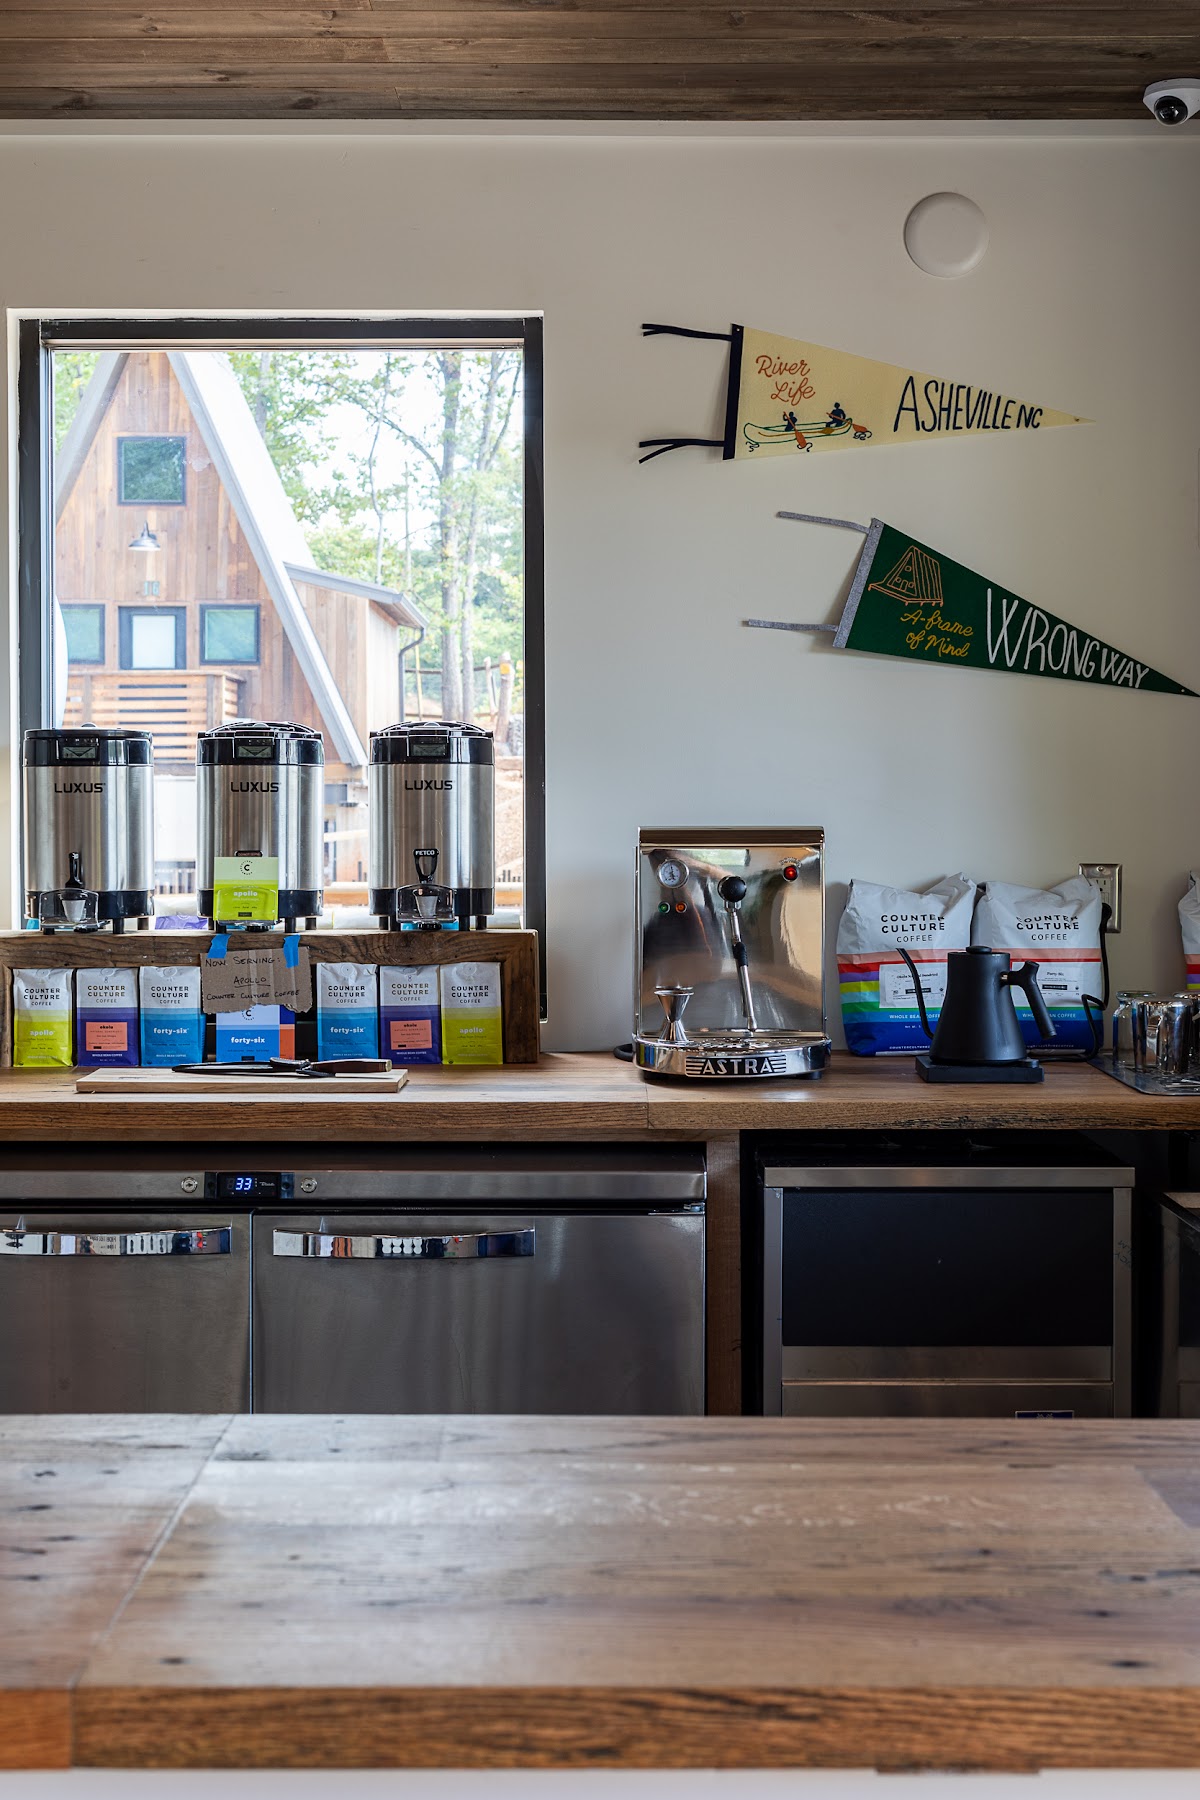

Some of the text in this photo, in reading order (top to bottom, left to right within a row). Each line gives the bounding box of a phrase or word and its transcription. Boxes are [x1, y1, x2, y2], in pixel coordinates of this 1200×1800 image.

[755, 354, 811, 378] River
[770, 377, 816, 406] Life
[893, 375, 1043, 432] ASHEVILLE NC
[900, 609, 974, 636] A-frame
[905, 630, 970, 658] of Mind
[986, 588, 1150, 689] WRONG WAY
[54, 782, 104, 793] LUXUS
[230, 781, 279, 793] LUXUS
[404, 780, 453, 791] LUXUS
[881, 922, 945, 934] CULTURE
[1016, 922, 1079, 930] CULTURE
[896, 934, 933, 943] COFFEE
[1031, 933, 1068, 941] COFFEE
[233, 976, 267, 984] APOLLO
[274, 990, 300, 998] COFFEE
[153, 1027, 188, 1035] forty-six
[330, 1026, 364, 1034] forty-six
[230, 1036, 265, 1044] forty-six
[702, 1057, 773, 1075] ASTRA
[235, 1177, 253, 1191] 33
